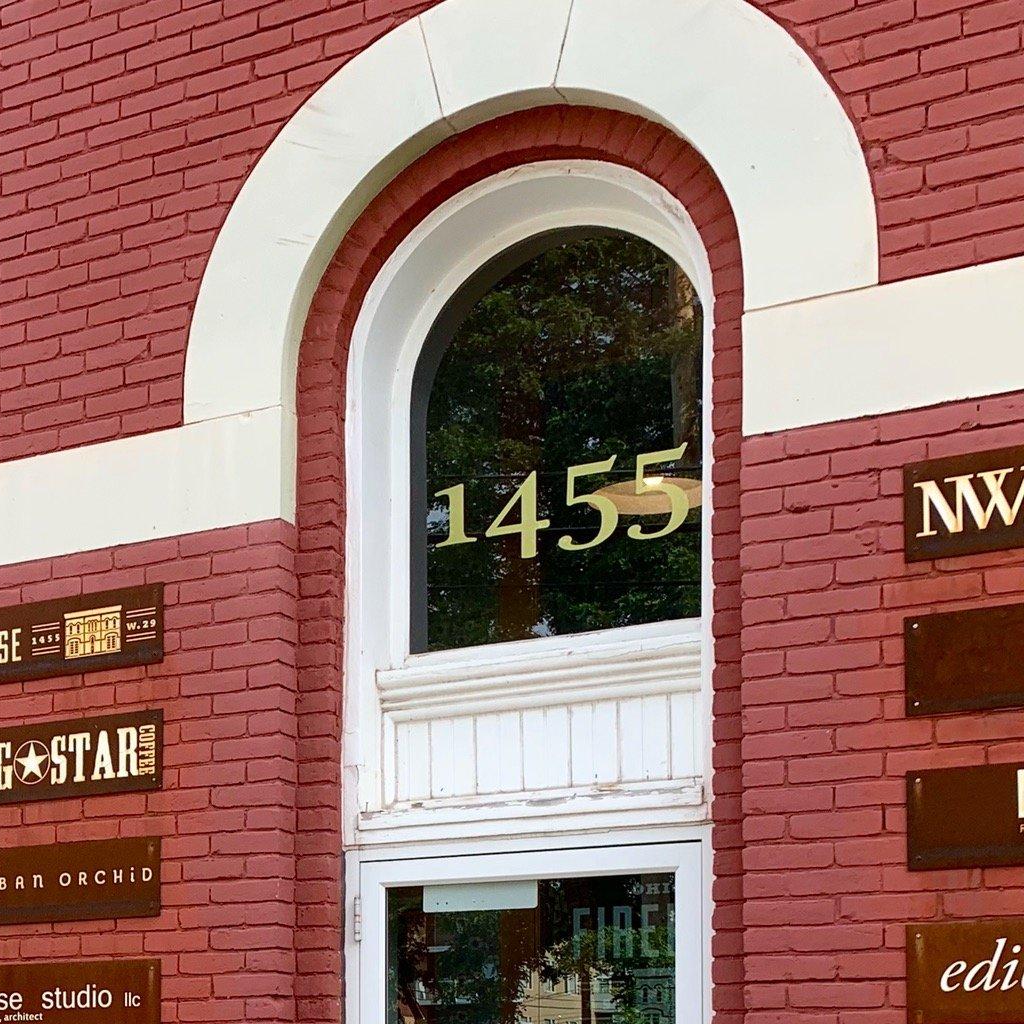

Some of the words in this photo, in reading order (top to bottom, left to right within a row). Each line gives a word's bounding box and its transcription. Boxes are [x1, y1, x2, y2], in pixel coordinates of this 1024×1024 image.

[434, 441, 690, 559] 1455
[126, 619, 156, 631] W.29
[32, 634, 61, 645] 1455
[50, 726, 140, 785] STAR
[139, 724, 155, 775] COFFEE
[632, 883, 675, 895] OHI
[41, 984, 112, 1010] studio
[124, 992, 141, 1007] llc
[4, 1012, 43, 1022] architect
